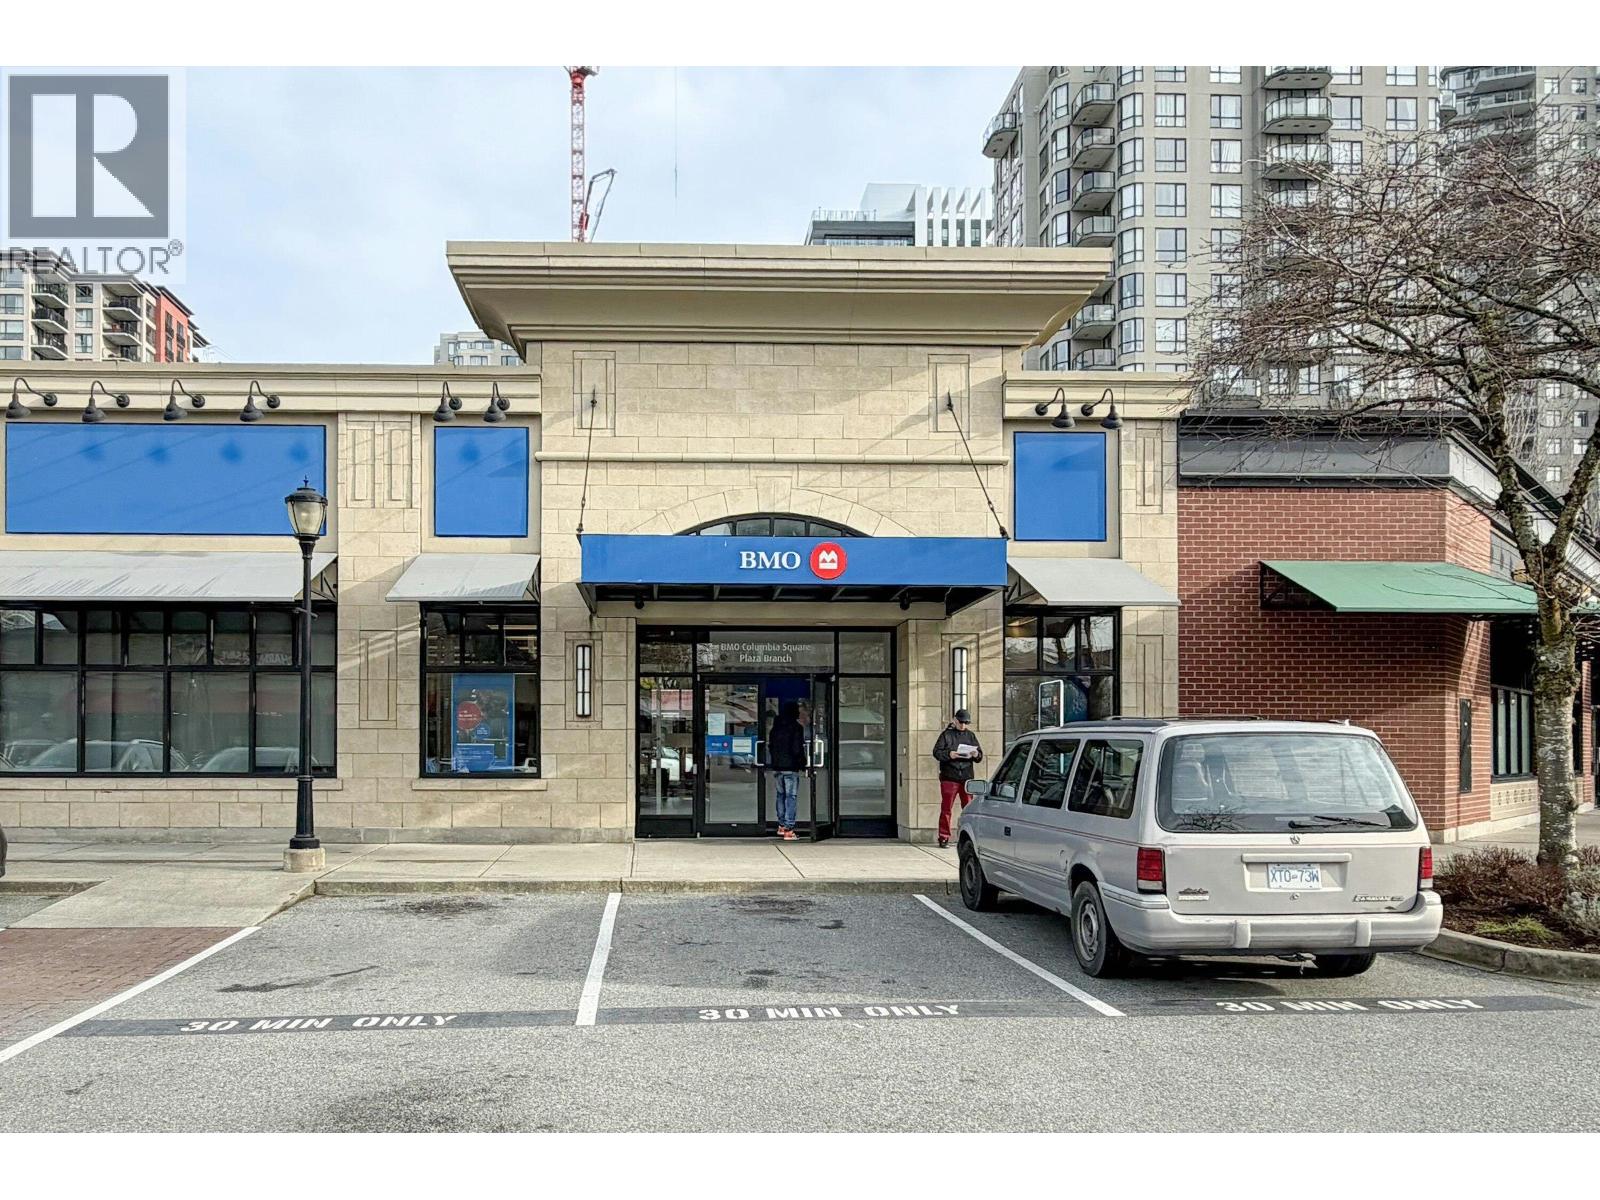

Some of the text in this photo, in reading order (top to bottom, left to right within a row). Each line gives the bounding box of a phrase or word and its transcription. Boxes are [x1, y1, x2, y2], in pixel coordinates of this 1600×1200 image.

[739, 551, 801, 570] BMO
[720, 643, 811, 653] BMO Columbia Square
[739, 654, 792, 663] Plaza Branch
[698, 1004, 960, 1020] 30 MIN ONLY
[1215, 999, 1484, 1012] 30 MIN ONLY
[179, 1014, 458, 1032] 30 MIN ONLY
